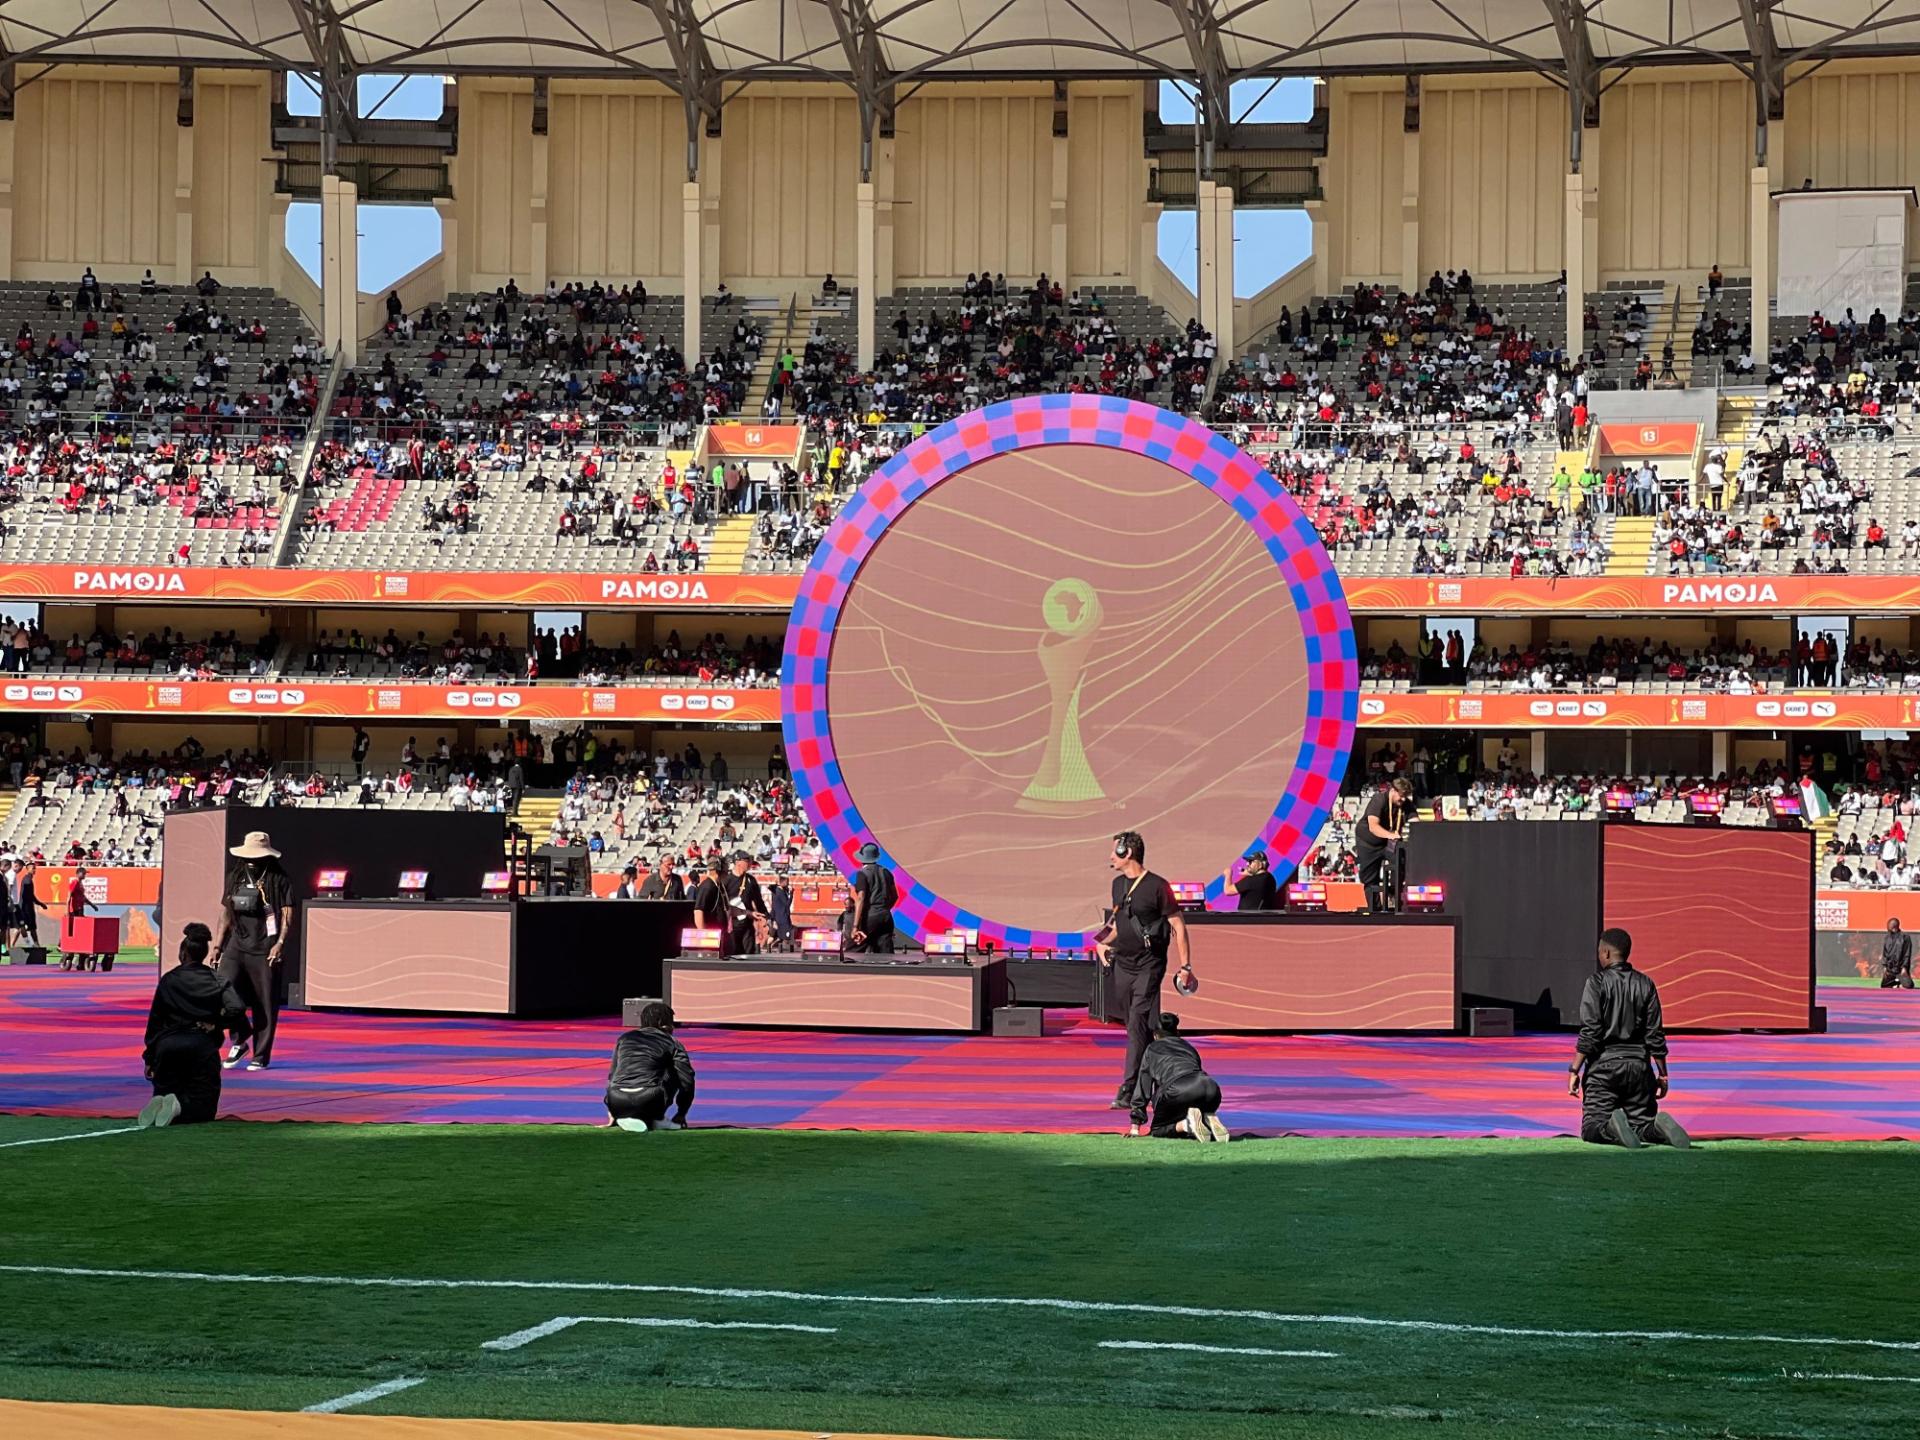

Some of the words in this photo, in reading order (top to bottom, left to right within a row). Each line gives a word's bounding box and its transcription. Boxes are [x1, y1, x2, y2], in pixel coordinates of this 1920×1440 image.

[747, 432, 761, 443] 14
[1642, 431, 1656, 442] 13
[74, 572, 185, 591] PAMOJA
[602, 580, 708, 599] PAMOJA
[1663, 583, 1778, 602] PAMOJA
